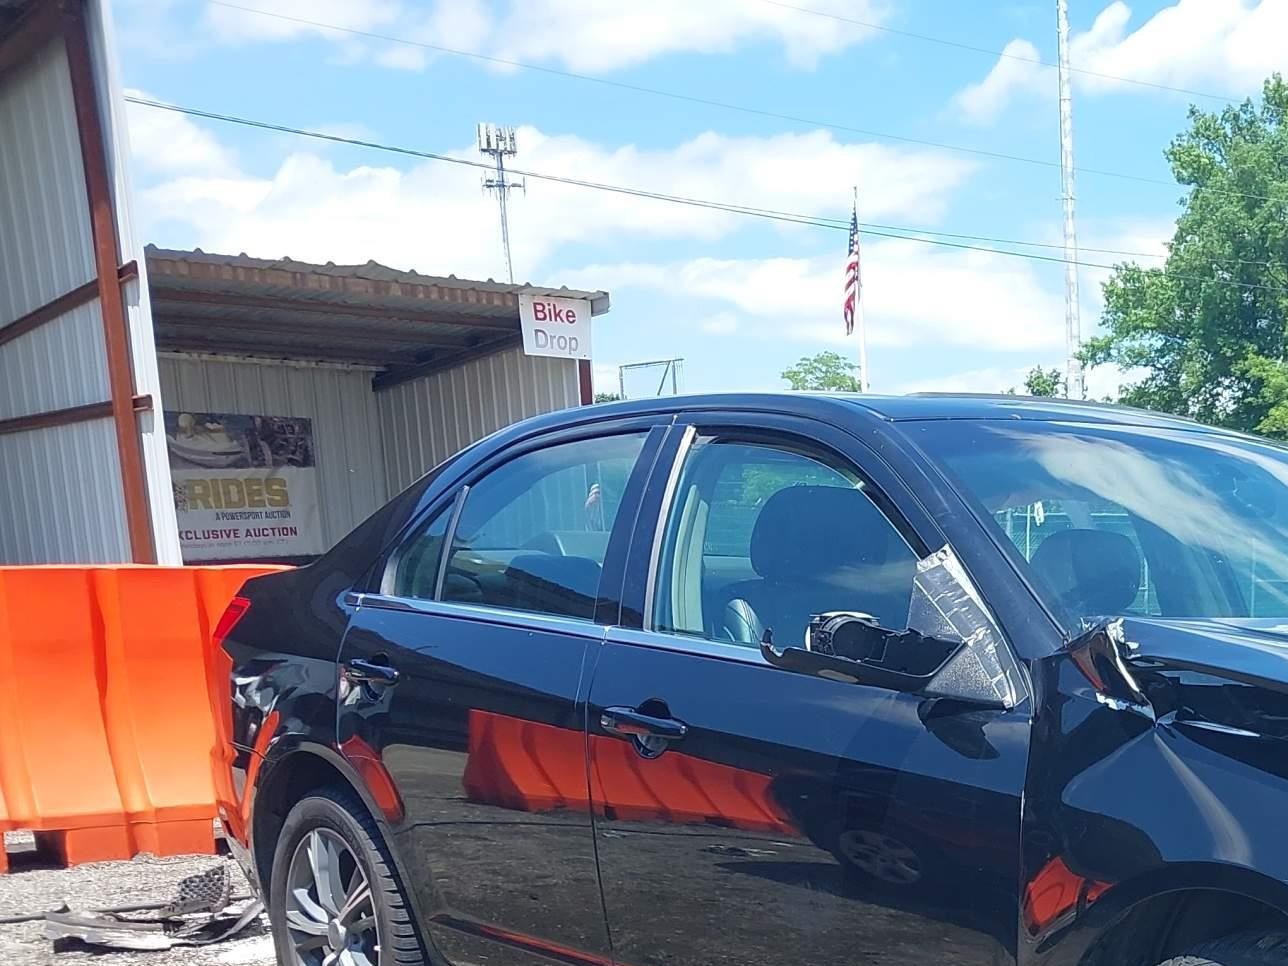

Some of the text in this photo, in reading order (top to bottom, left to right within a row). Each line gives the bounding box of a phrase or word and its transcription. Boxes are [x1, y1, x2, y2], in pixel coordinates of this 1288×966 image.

[533, 302, 576, 324] Bike
[534, 329, 578, 355] Drop
[186, 478, 289, 510] RIDES
[215, 510, 291, 520] A POWERSPORT AUCTION
[245, 526, 298, 538] AUCTION
